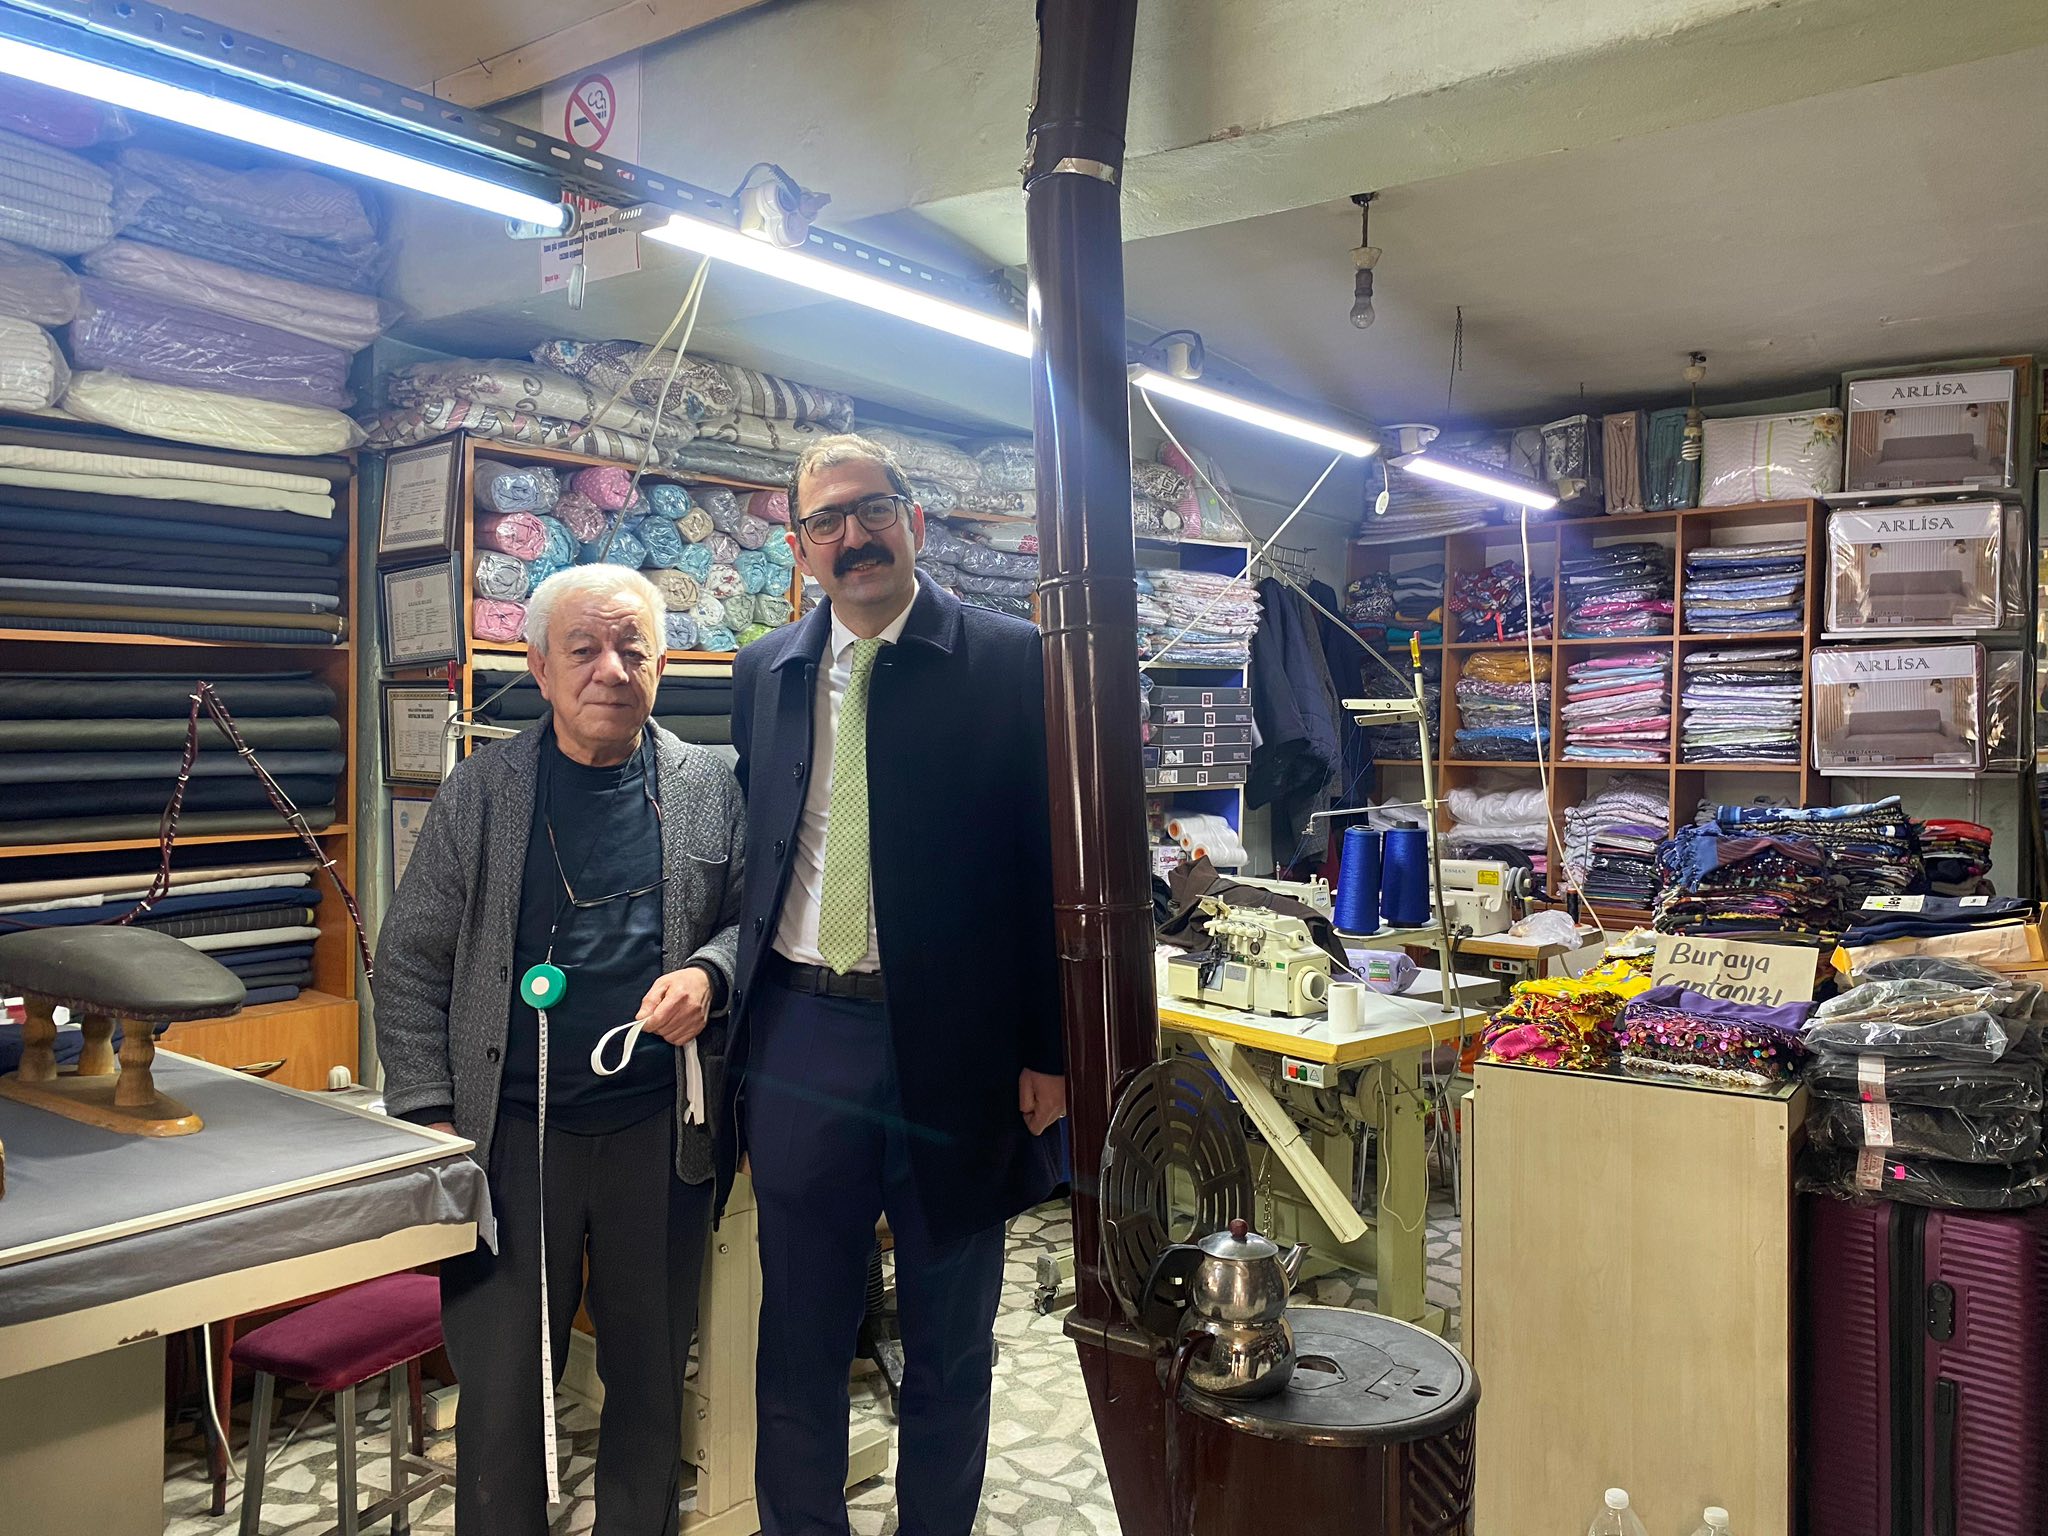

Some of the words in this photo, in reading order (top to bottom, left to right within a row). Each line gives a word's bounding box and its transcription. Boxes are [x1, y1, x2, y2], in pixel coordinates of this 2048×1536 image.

[1891, 381, 1968, 399] ARLİSA
[1877, 515, 1955, 533] ARLİSA
[1854, 655, 1930, 673] ARLİSA
[1669, 942, 1770, 981] Buraya
